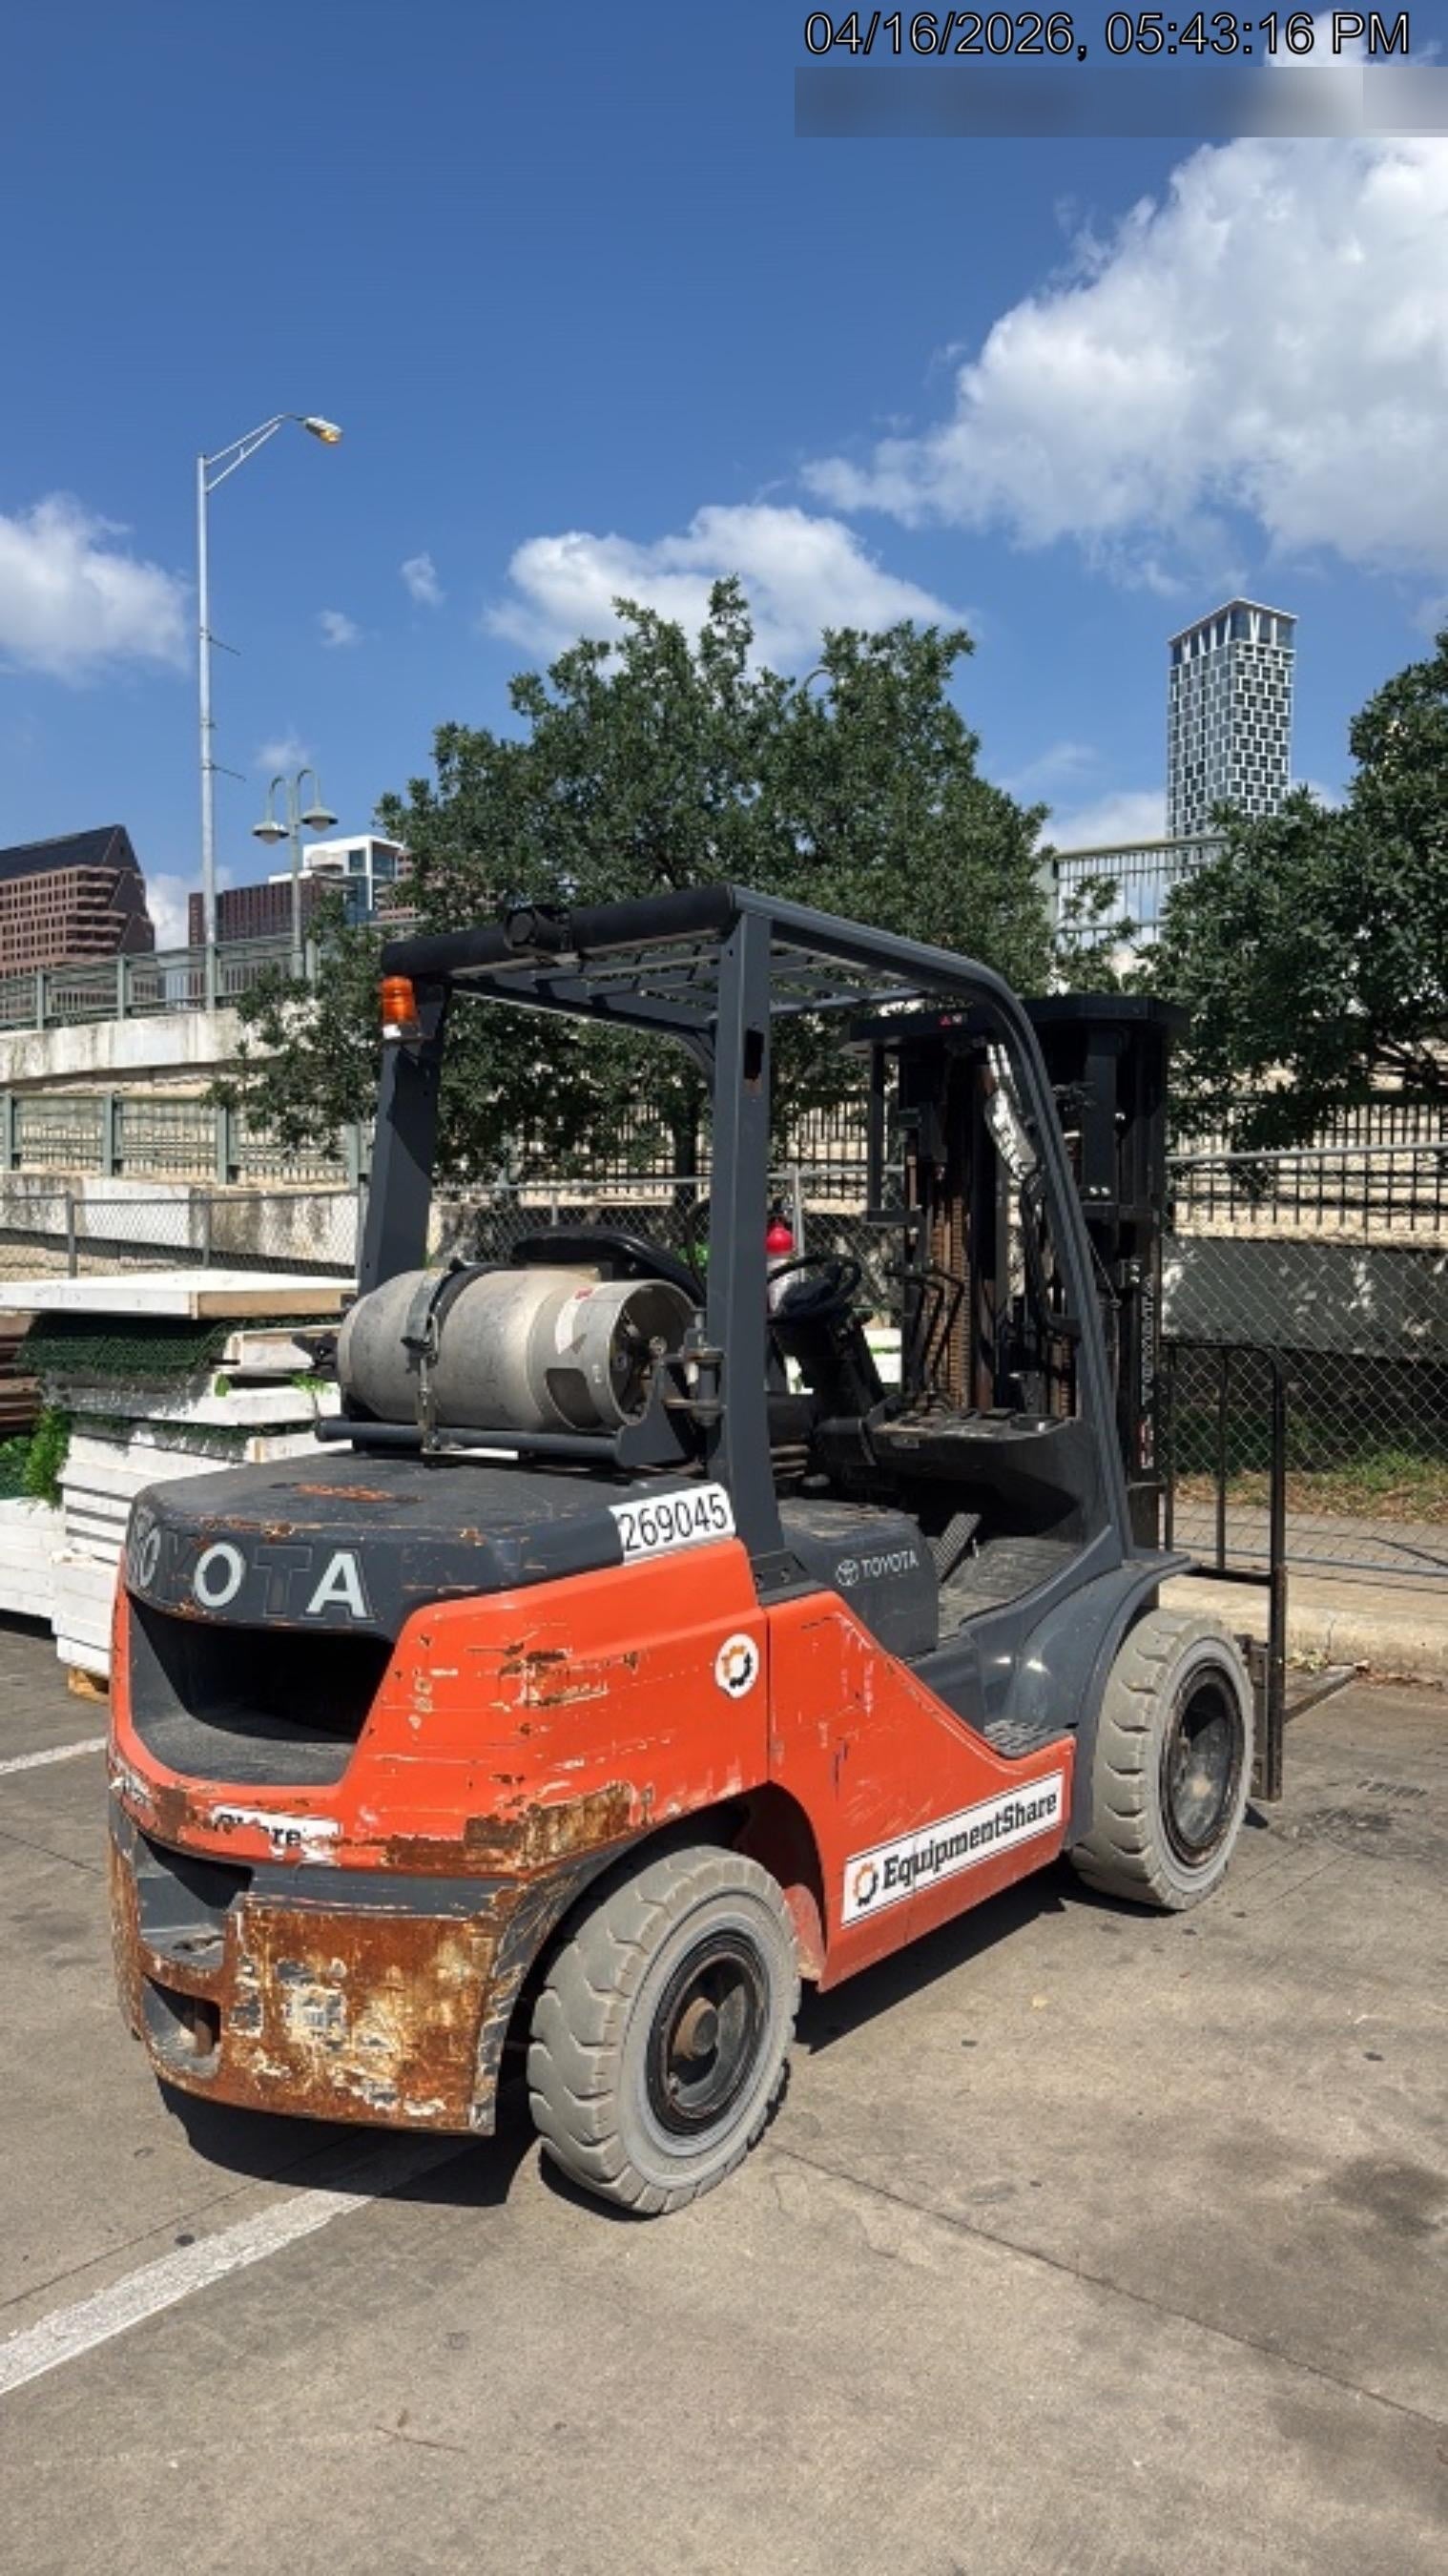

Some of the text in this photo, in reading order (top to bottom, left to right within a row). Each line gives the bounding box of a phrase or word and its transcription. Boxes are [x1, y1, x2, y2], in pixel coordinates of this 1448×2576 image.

[618, 1492, 729, 1553] 269045
[859, 1548, 921, 1579] TOYOTA
[883, 1792, 1058, 1890] EquipmentShare
